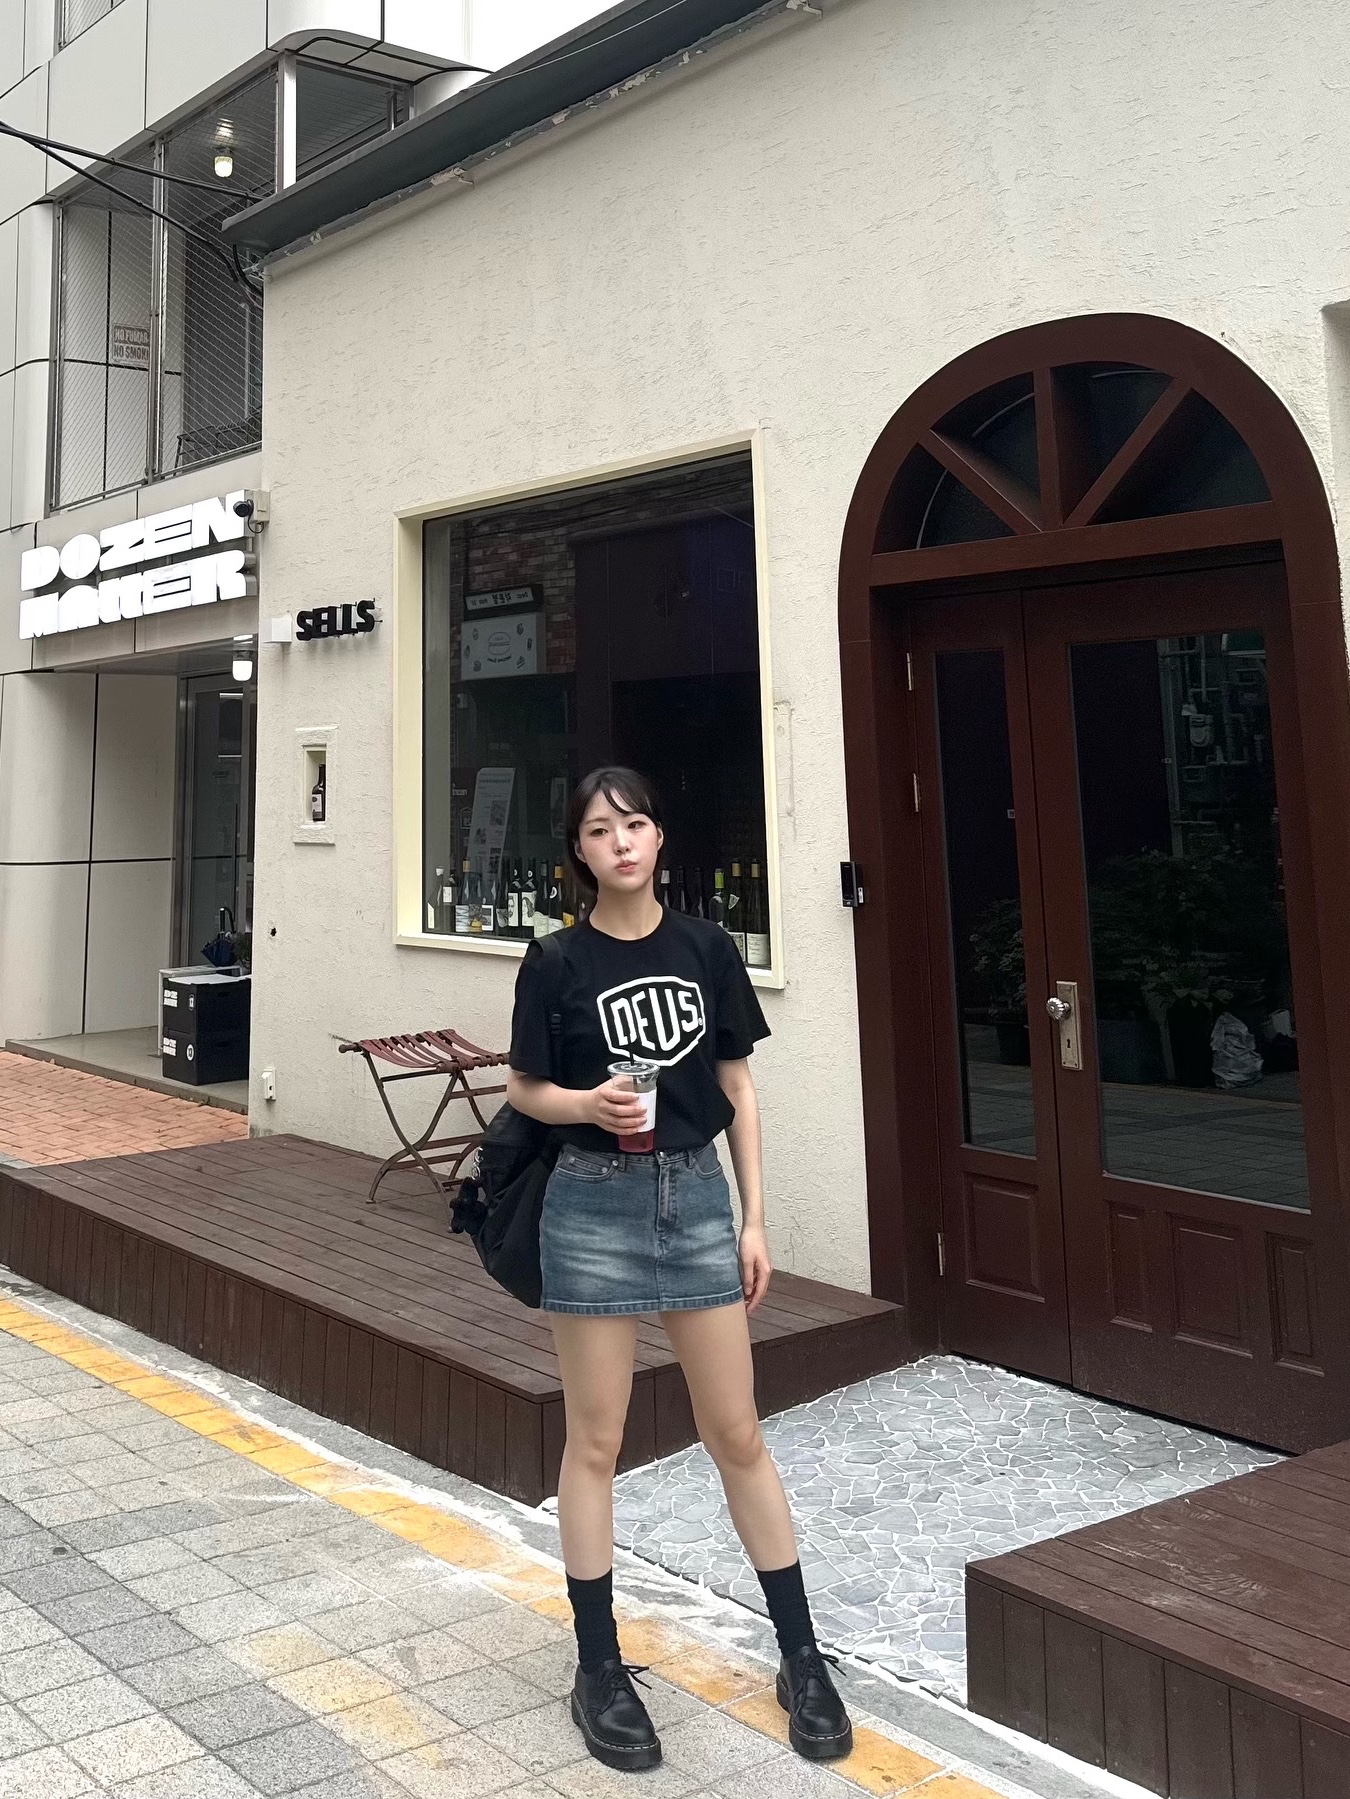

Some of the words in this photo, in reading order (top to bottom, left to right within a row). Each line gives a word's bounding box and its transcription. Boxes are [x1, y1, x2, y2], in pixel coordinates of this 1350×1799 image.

[114, 328, 125, 341] NO
[114, 344, 124, 357] NO
[21, 489, 245, 591] DOZEN
[610, 987, 699, 1051] DEUS
